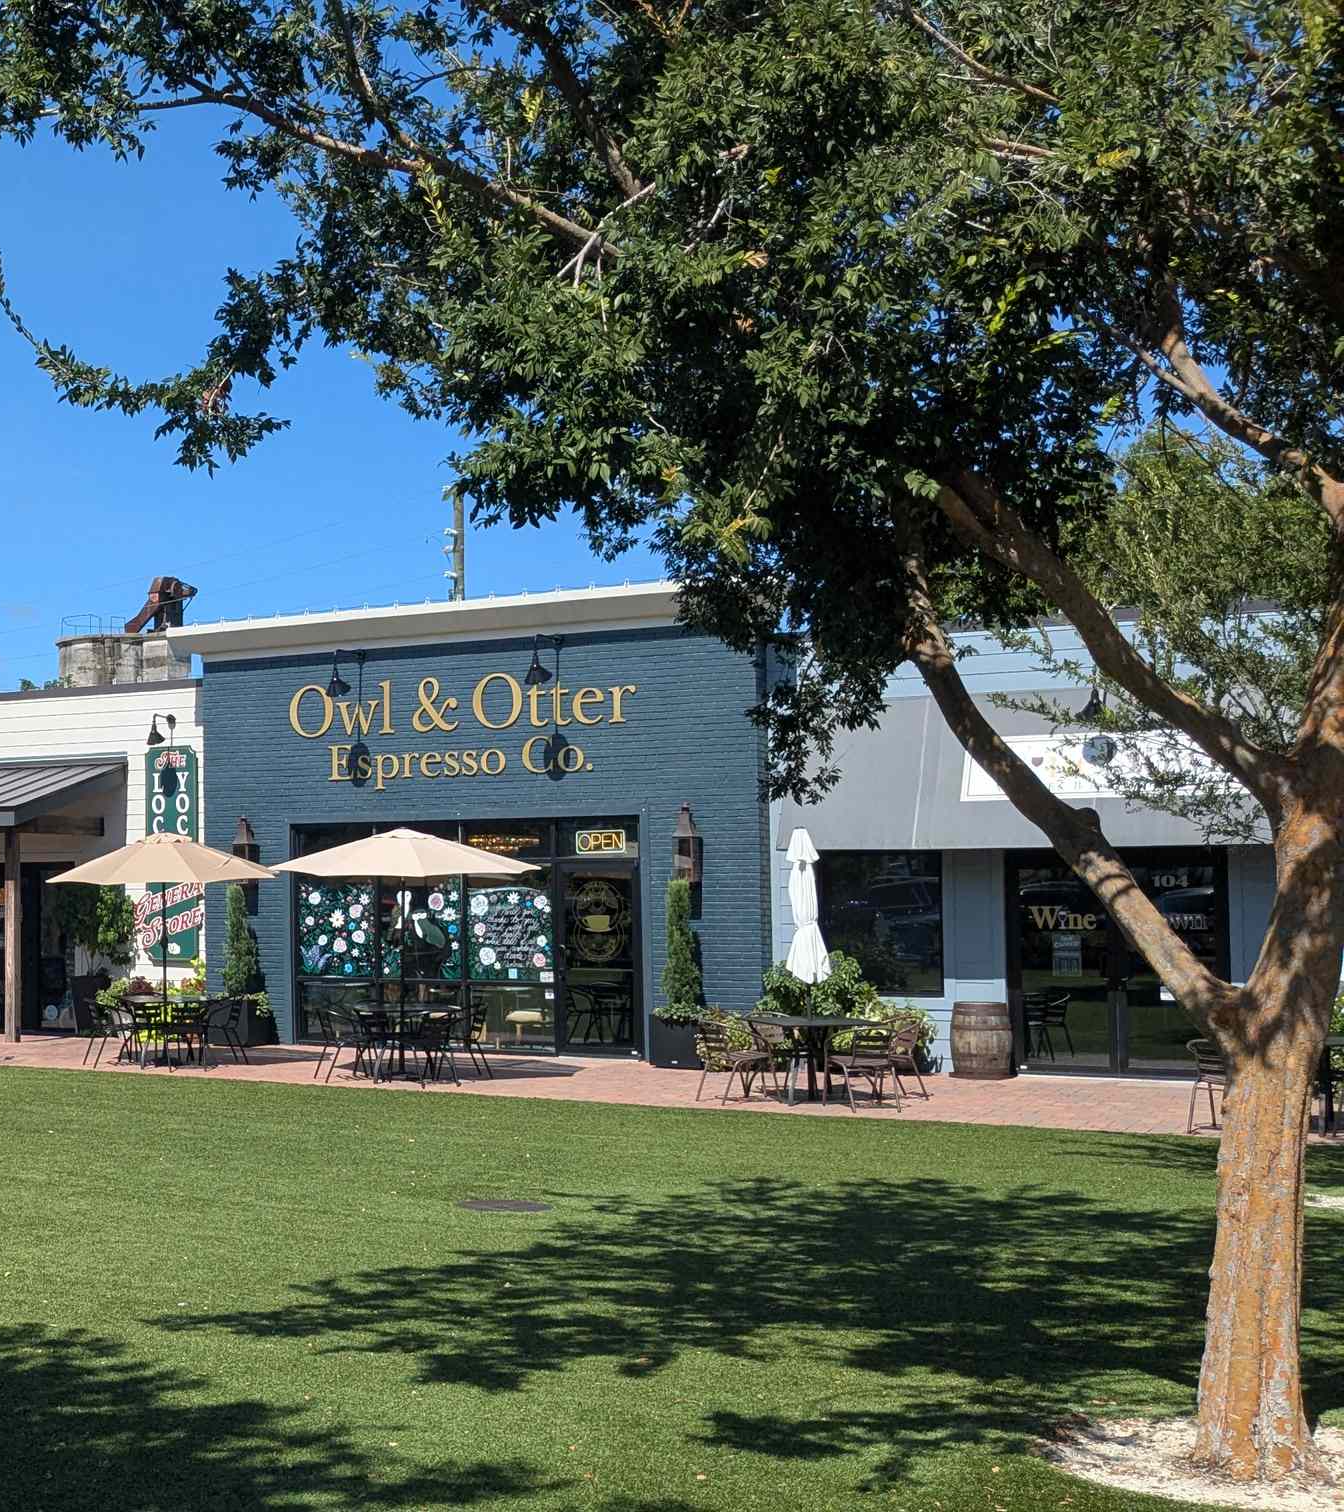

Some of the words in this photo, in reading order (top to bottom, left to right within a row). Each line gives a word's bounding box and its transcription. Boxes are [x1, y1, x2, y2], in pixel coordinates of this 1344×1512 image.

[287, 679, 398, 741] Owl
[411, 676, 460, 733] &
[471, 672, 639, 731] Otter
[326, 745, 507, 791] Espresso
[521, 734, 594, 776] Co.
[152, 773, 166, 835] LOC
[176, 772, 190, 835] YOC
[578, 834, 623, 850] OPEN
[135, 881, 204, 927] GENERA
[1152, 874, 1190, 888] 104
[142, 908, 203, 949] SORE
[1028, 905, 1097, 930] Wine
